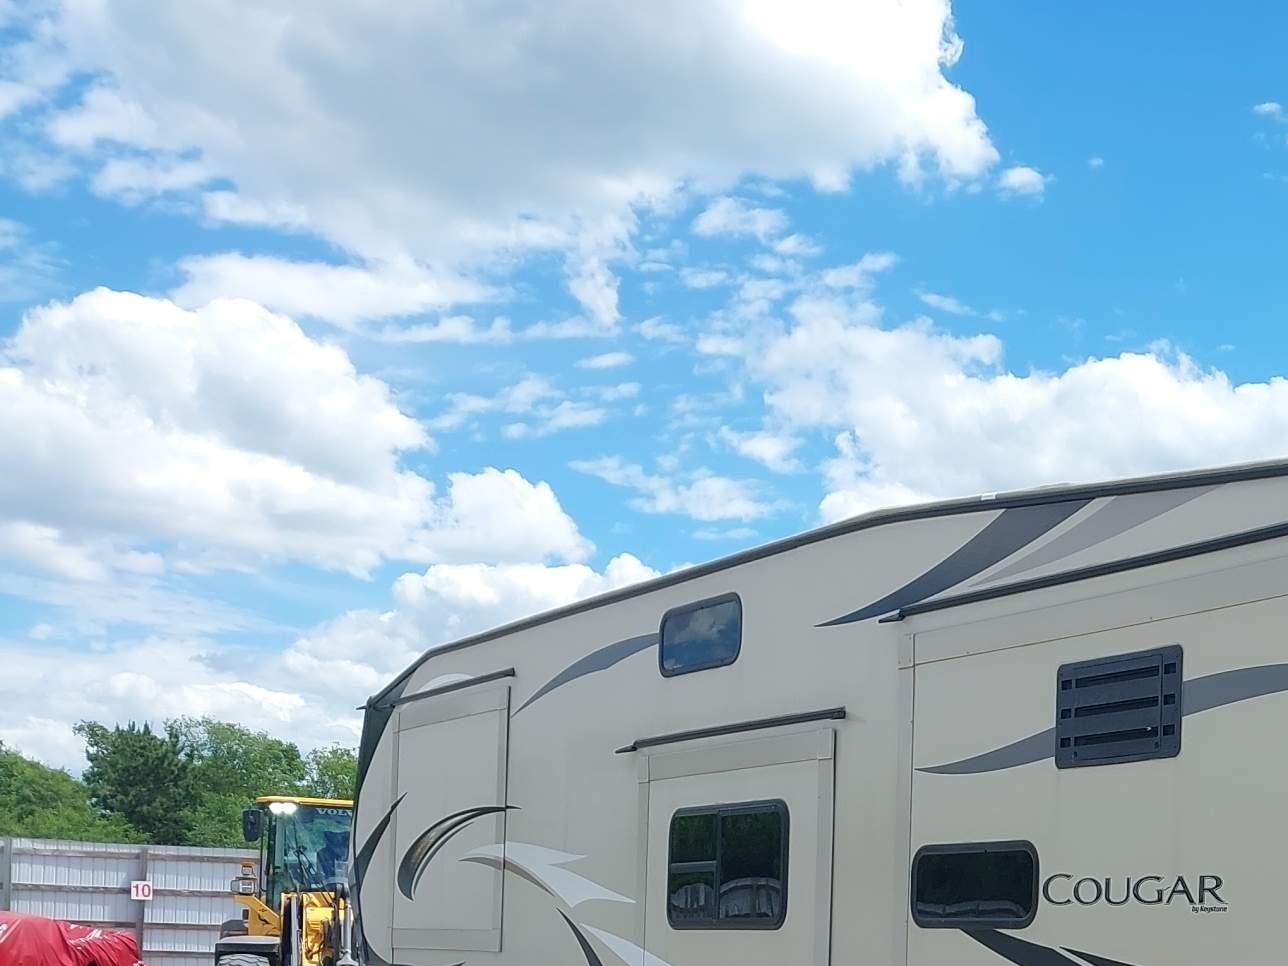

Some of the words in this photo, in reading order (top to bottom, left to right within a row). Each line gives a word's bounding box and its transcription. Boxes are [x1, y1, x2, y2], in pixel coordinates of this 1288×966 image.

[316, 807, 353, 817] VOLV
[132, 883, 151, 898] 10
[1042, 873, 1228, 905] COUGAR
[1191, 905, 1199, 914] by
[1200, 905, 1228, 914] Keystone
